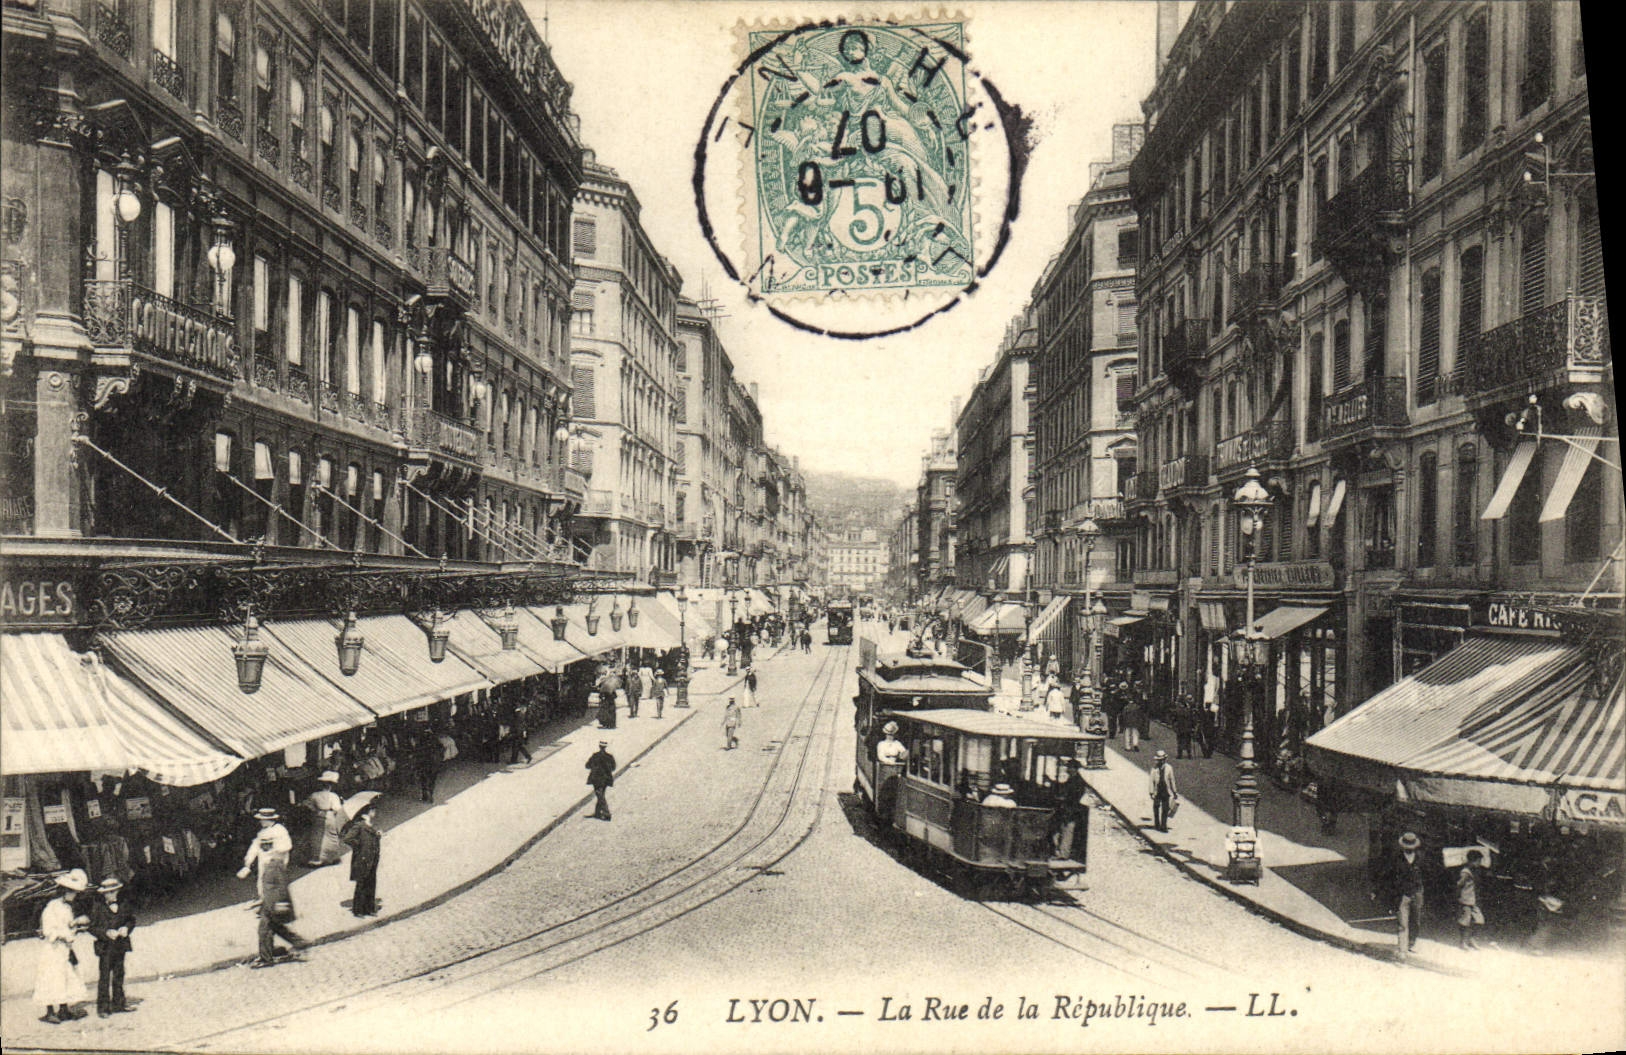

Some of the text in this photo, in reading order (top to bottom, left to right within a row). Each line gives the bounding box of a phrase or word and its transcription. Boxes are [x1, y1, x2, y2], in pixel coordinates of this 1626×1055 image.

[849, 181, 885, 245] 5
[820, 262, 913, 287] POSTES
[1, 581, 73, 617] AGES
